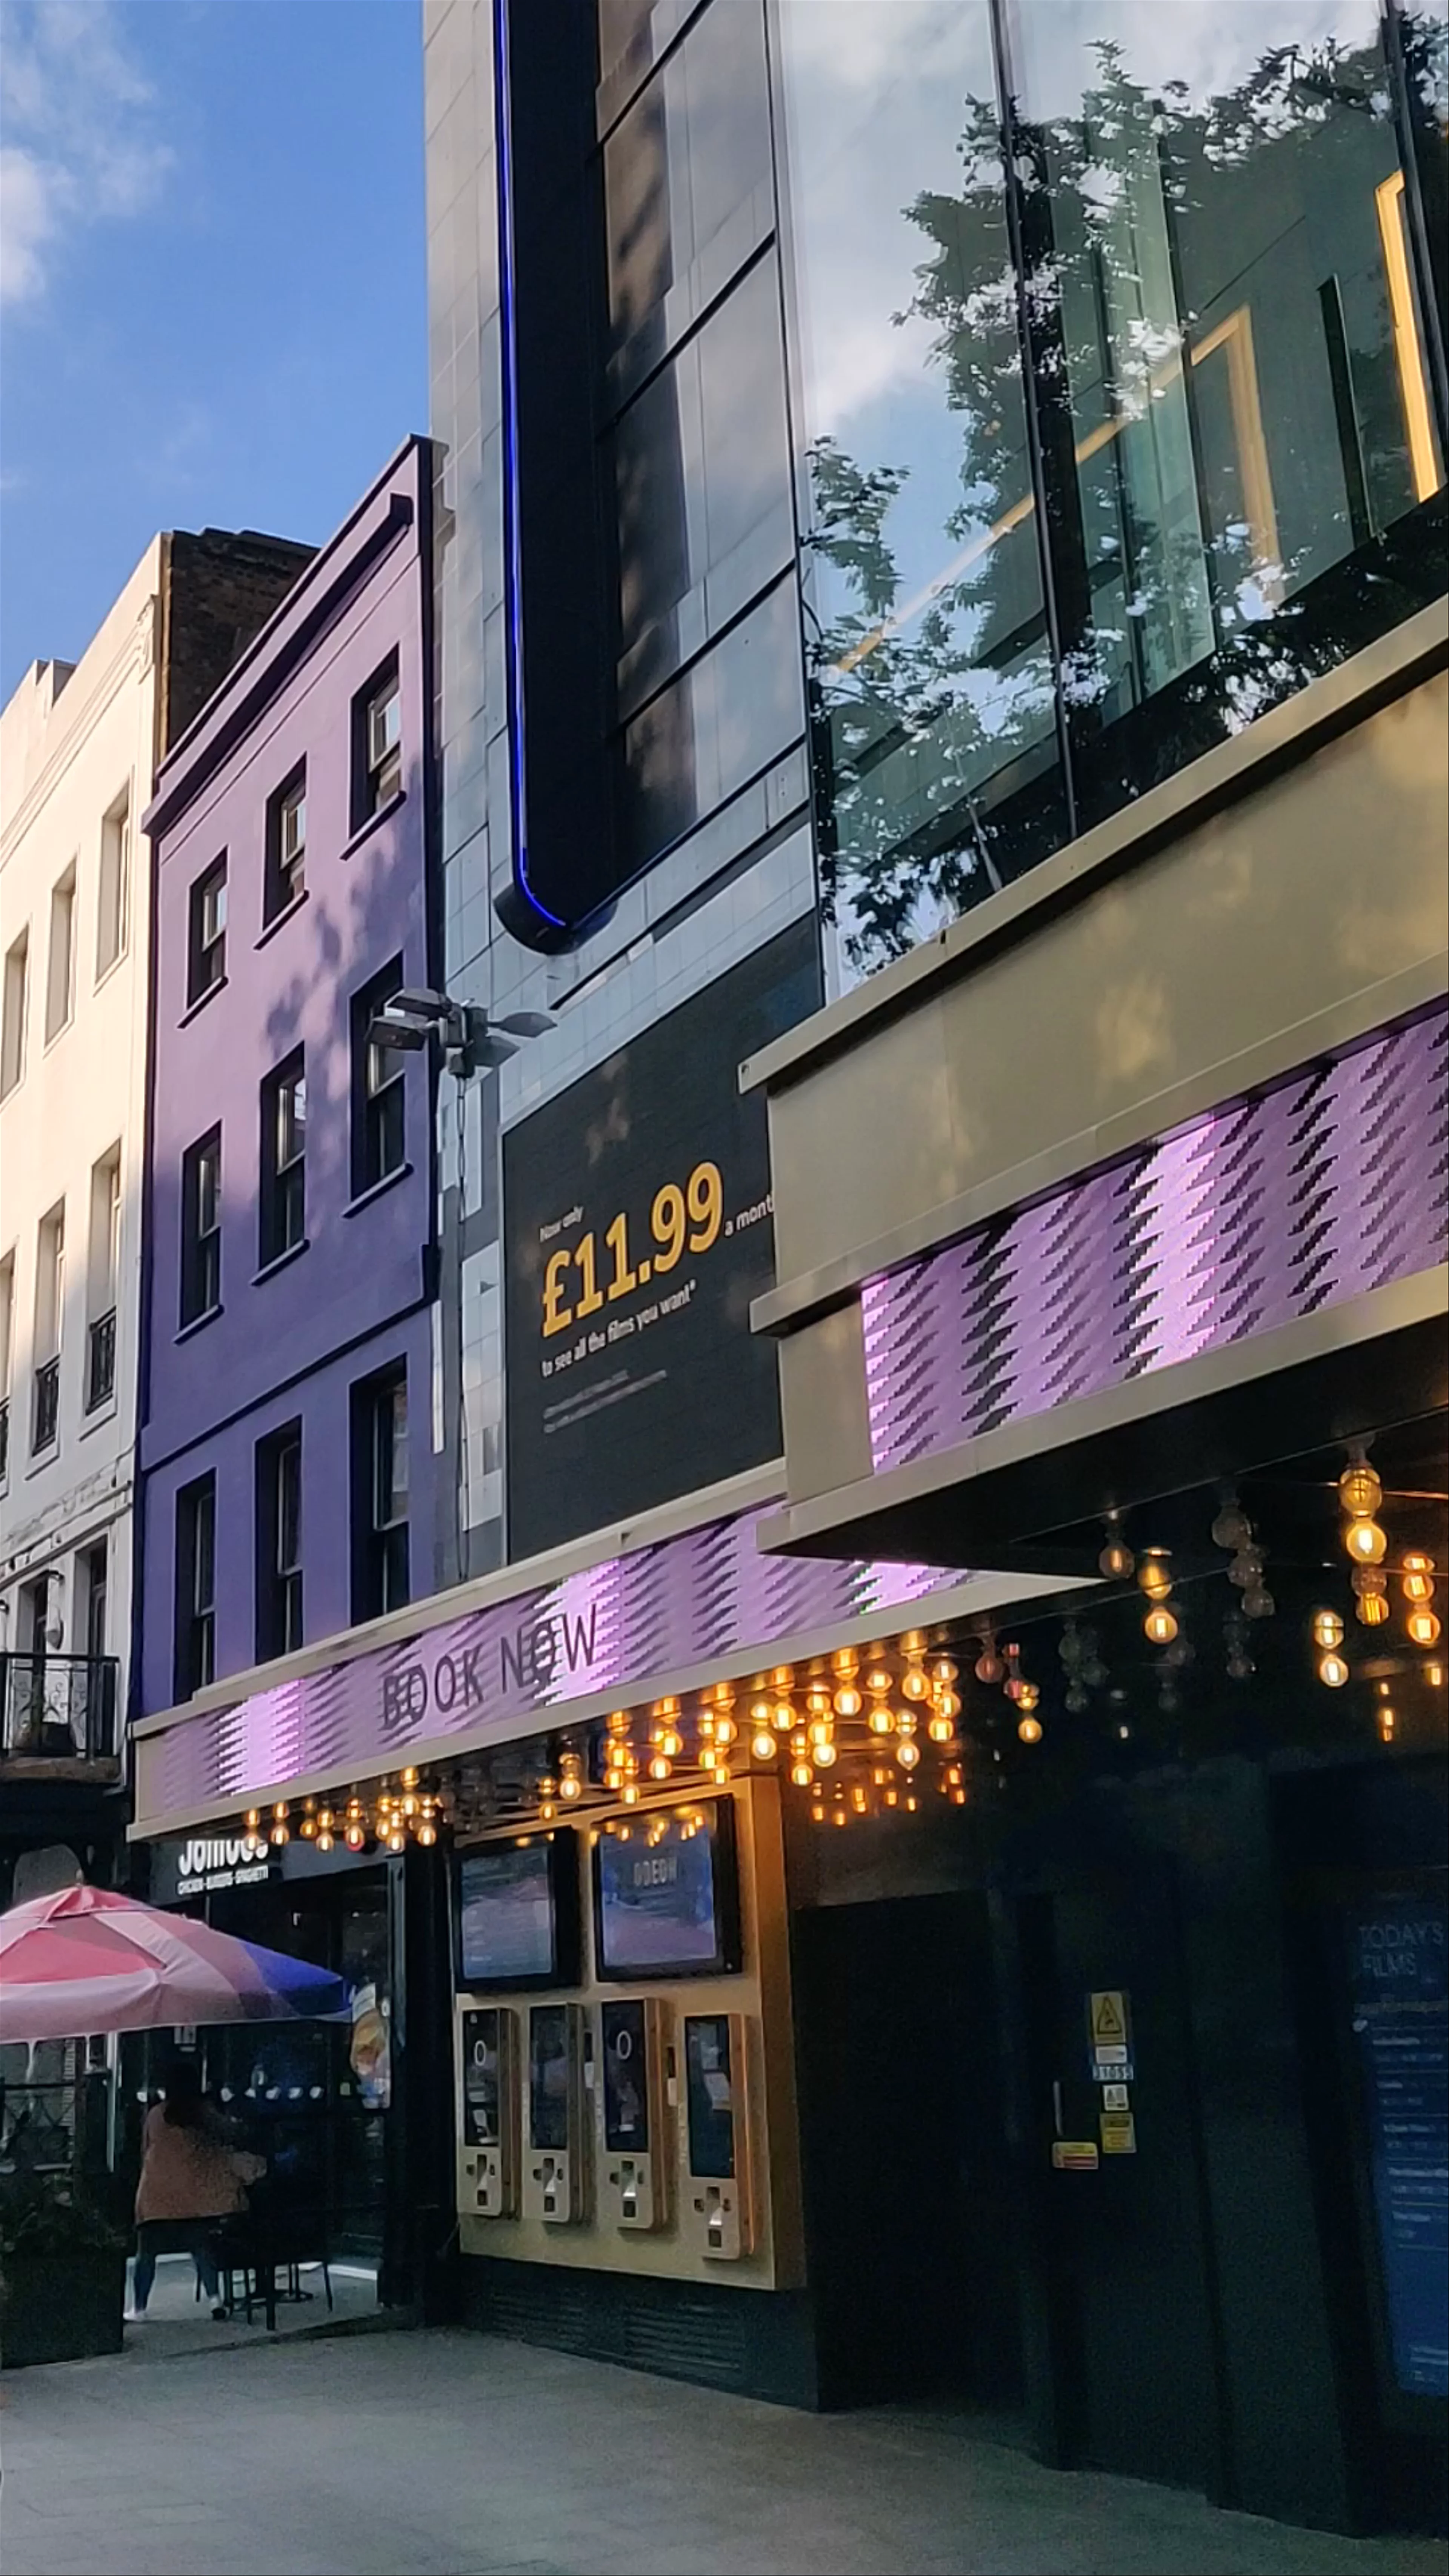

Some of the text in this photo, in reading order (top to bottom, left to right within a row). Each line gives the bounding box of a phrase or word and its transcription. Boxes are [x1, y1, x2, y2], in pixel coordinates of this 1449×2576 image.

[563, 1206, 584, 1227] only
[542, 1162, 774, 1338] £11.99 a mont
[542, 1360, 553, 1378] to
[555, 1350, 572, 1372] see
[574, 1336, 586, 1360] all
[588, 1332, 605, 1353] the
[607, 1320, 635, 1343] films
[635, 1304, 659, 1331] you
[383, 1603, 596, 1731] BOOK NOW
[634, 1856, 678, 1887] ODEON
[1358, 1921, 1444, 1949] TODAY'S
[1362, 1952, 1417, 1977] FILMS
